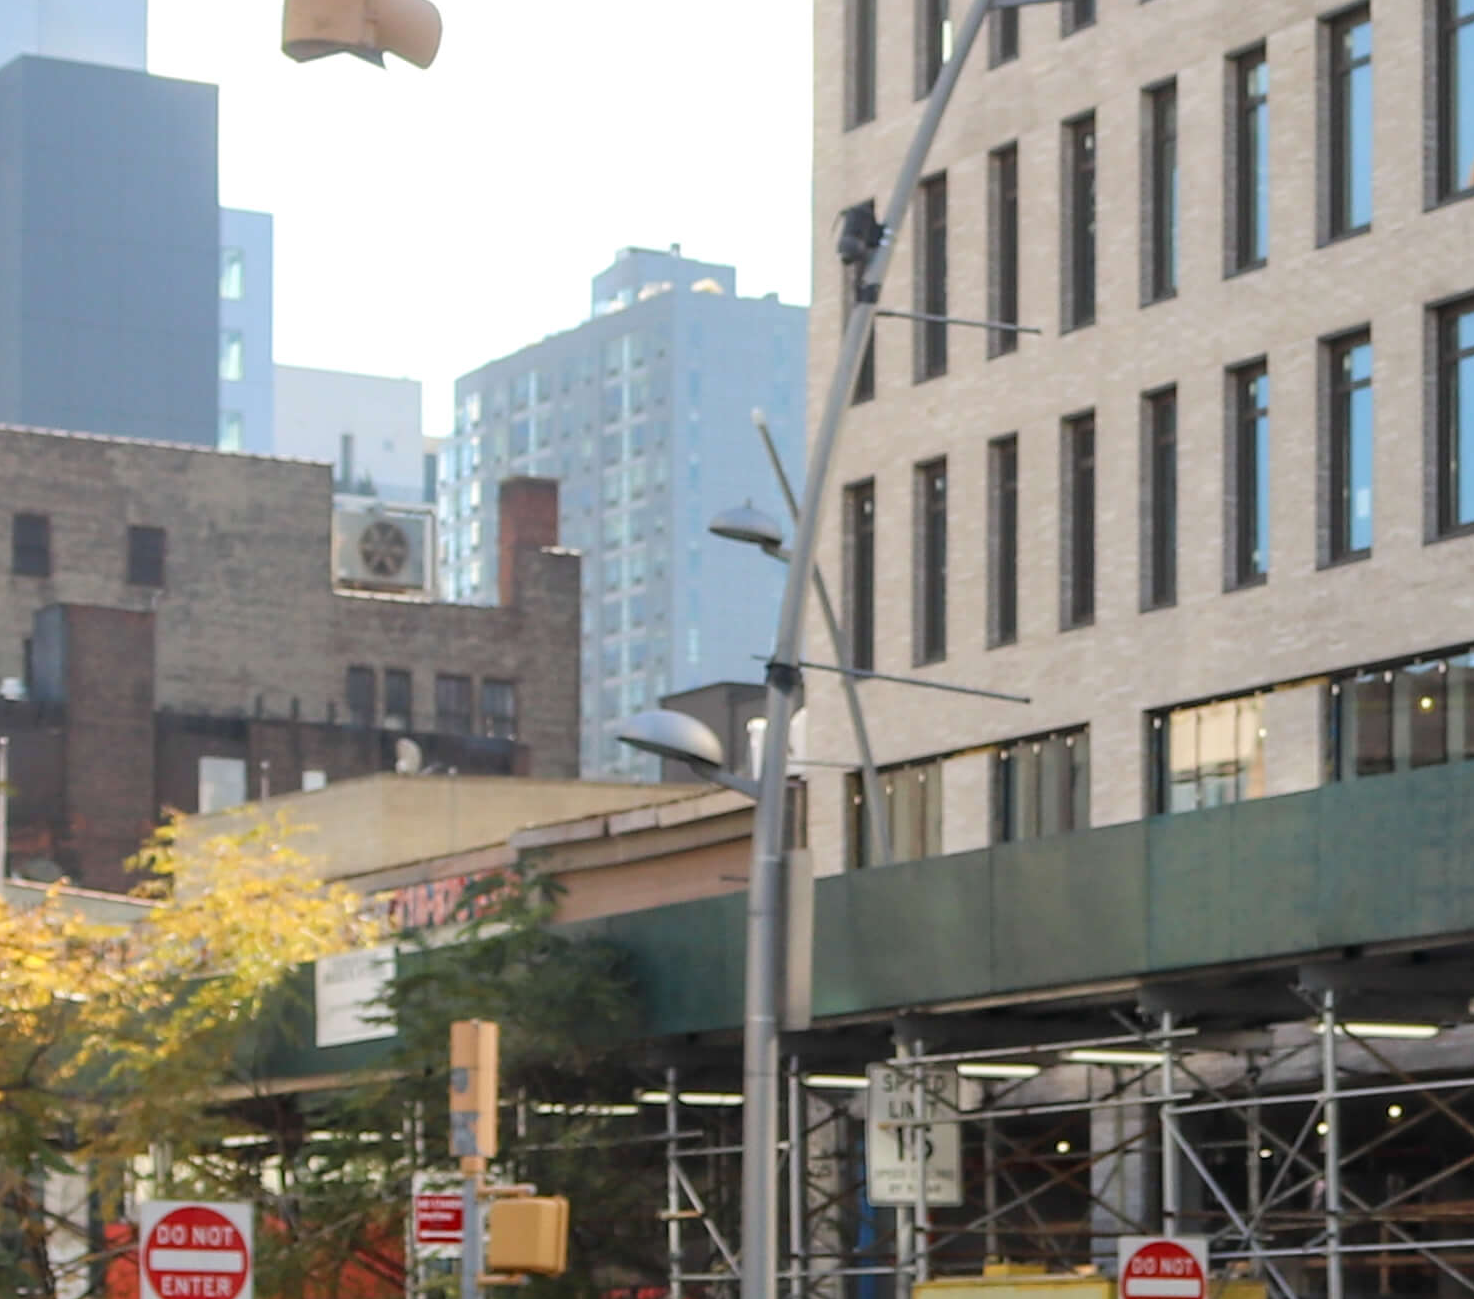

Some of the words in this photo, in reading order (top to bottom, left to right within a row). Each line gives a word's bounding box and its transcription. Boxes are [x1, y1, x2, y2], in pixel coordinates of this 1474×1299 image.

[156, 1224, 186, 1245] DO
[191, 1225, 234, 1246] NOT
[1131, 1257, 1156, 1275] DO
[1160, 1257, 1194, 1276] NOT
[161, 1276, 232, 1298] ENTER
